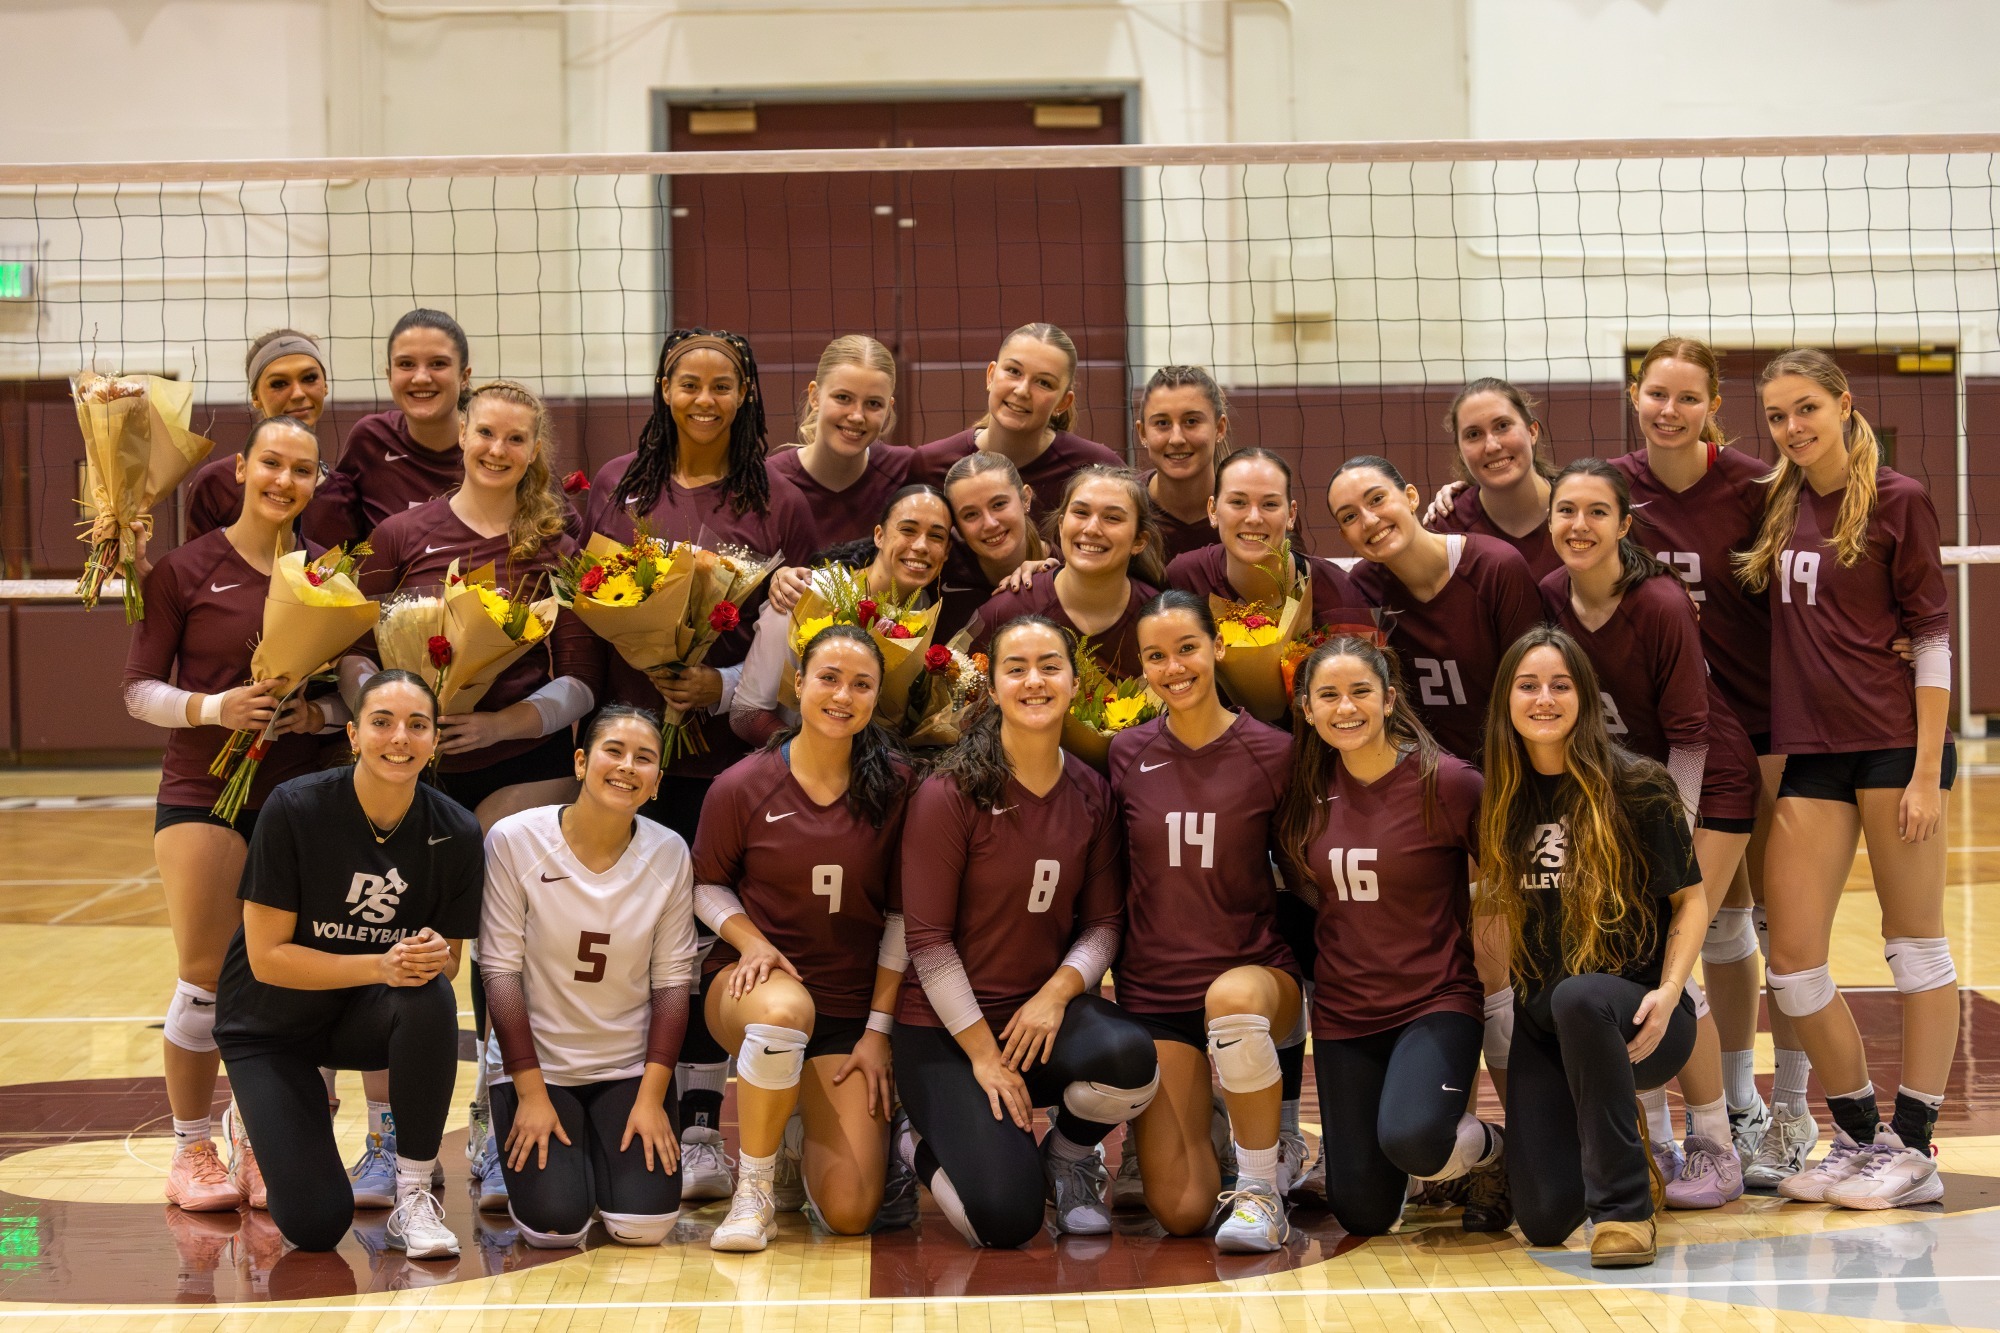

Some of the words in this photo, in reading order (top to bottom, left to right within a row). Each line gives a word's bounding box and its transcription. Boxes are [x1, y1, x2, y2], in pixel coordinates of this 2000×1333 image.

[1780, 550, 1821, 606] 19
[1414, 657, 1467, 706] 21
[1165, 811, 1216, 869] 14
[812, 864, 844, 914] 9
[1027, 859, 1060, 913] 8
[1328, 847, 1379, 902] 16
[574, 930, 611, 983] 5
